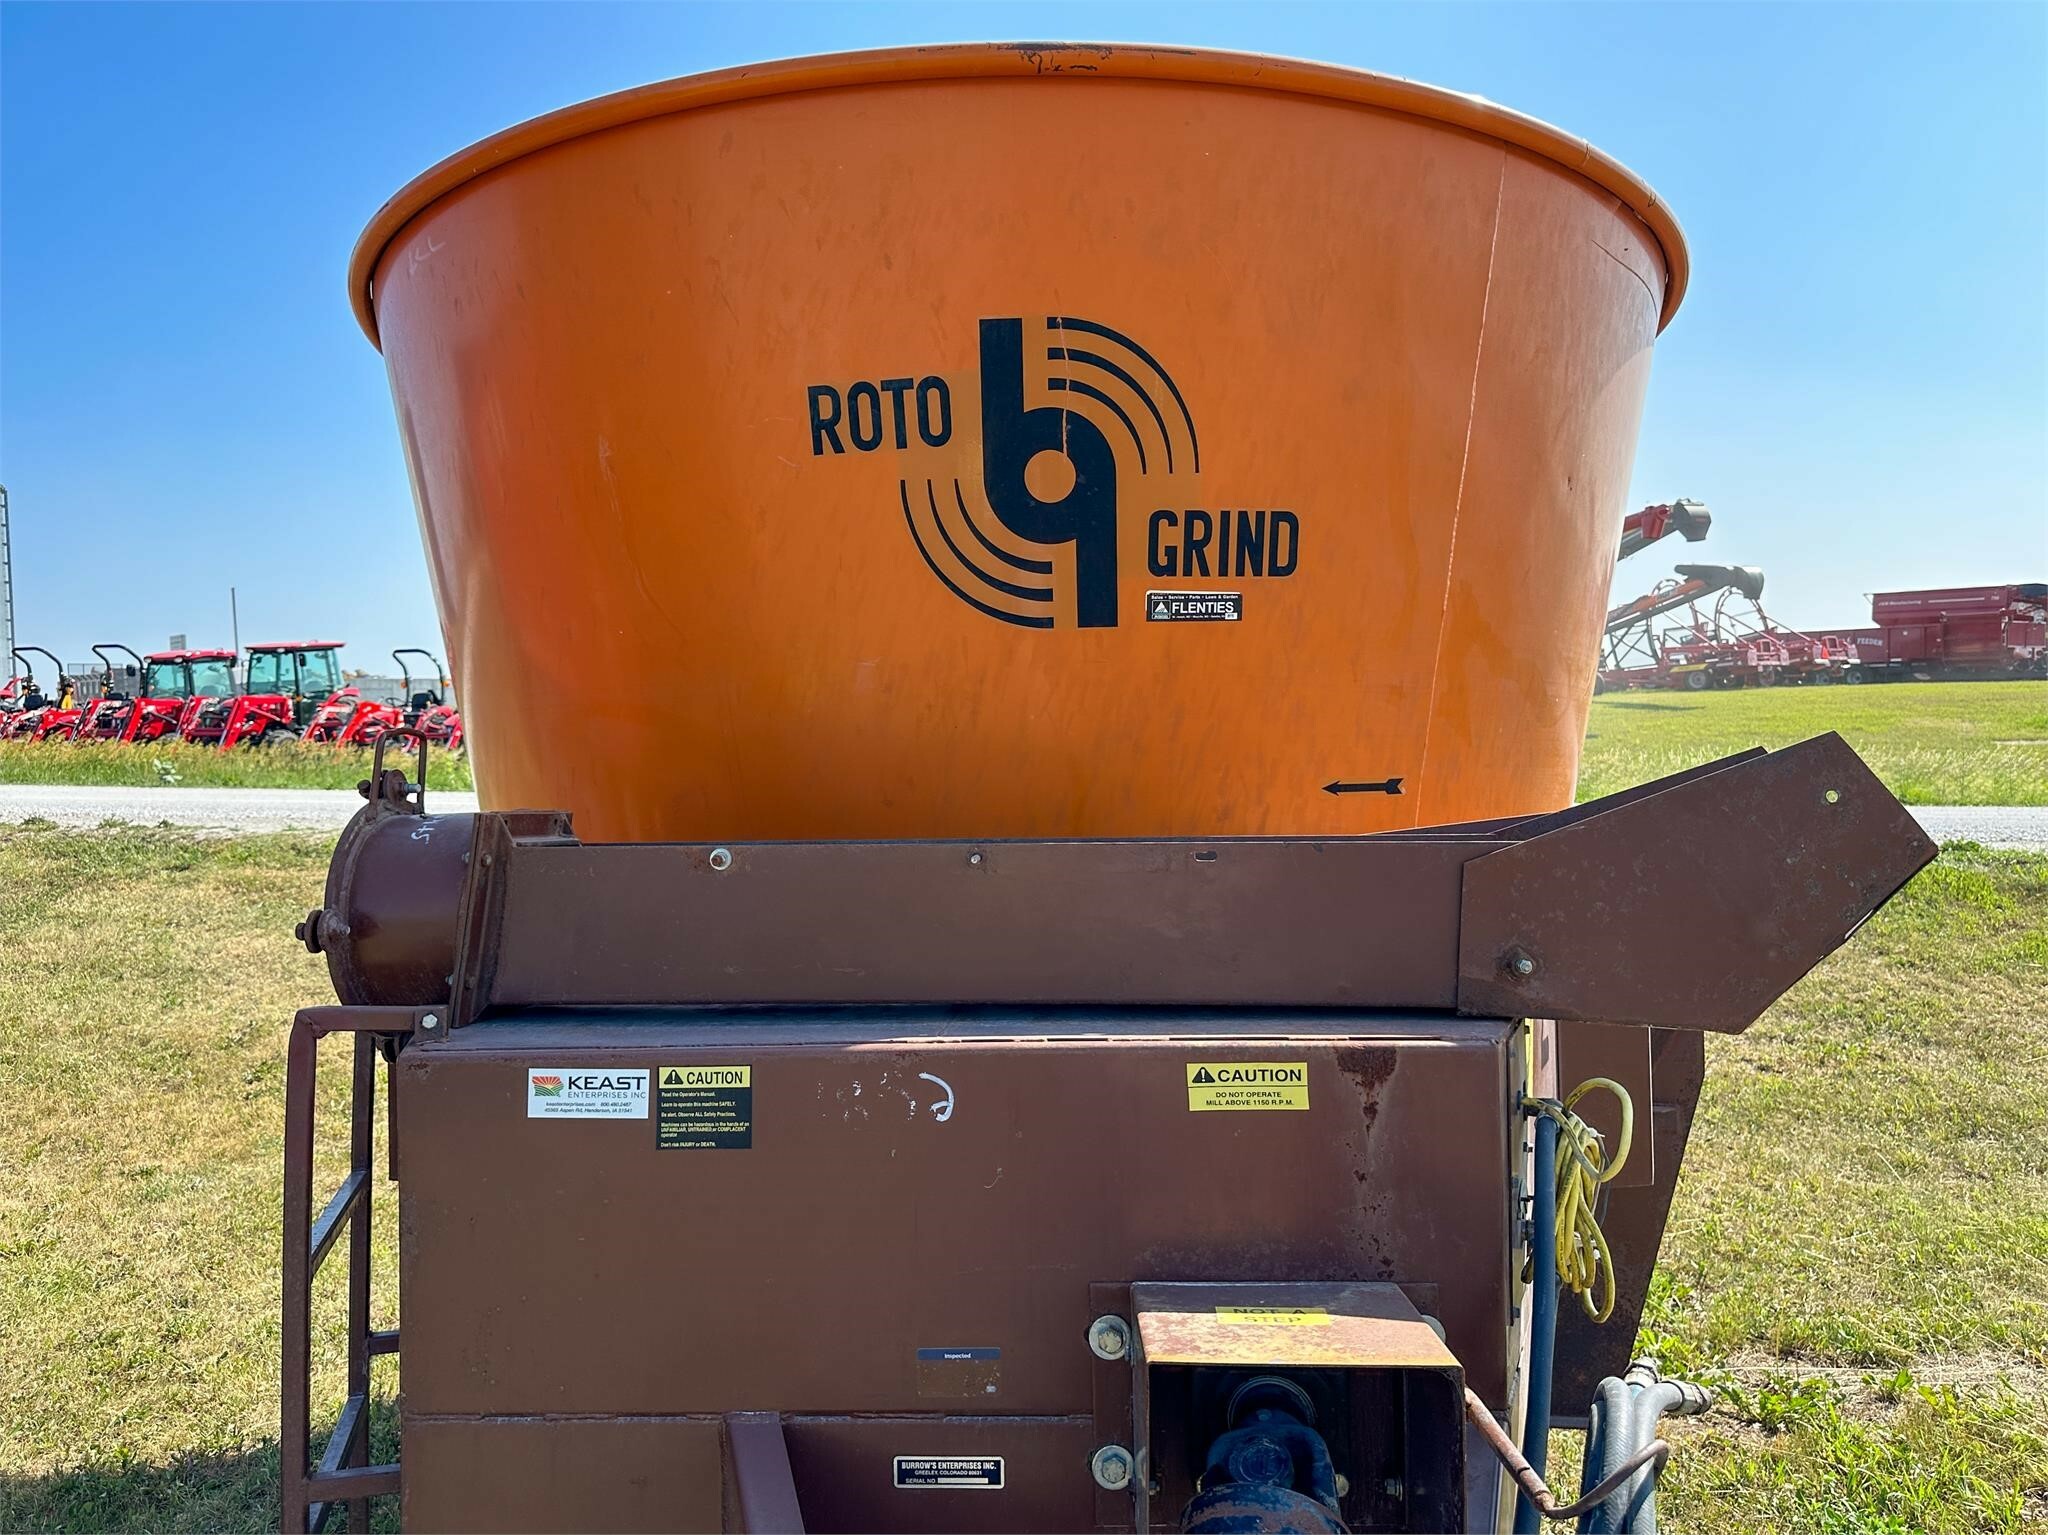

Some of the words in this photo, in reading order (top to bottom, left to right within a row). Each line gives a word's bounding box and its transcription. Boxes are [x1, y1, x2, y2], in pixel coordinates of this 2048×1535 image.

[807, 375, 952, 456] ROTO
[1147, 509, 1300, 578] GRIND
[1172, 601, 1234, 614] FLENTIES
[686, 1071, 743, 1085] CAUTION
[1217, 1069, 1302, 1082] CAUTION
[568, 1076, 647, 1090] KEAST
[567, 1091, 628, 1099] ENTERPRISES
[631, 1091, 646, 1099] INC
[901, 1461, 937, 1469] BURROW'S
[938, 1461, 982, 1469] ENTERPRISES
[983, 1461, 997, 1469] INC.
